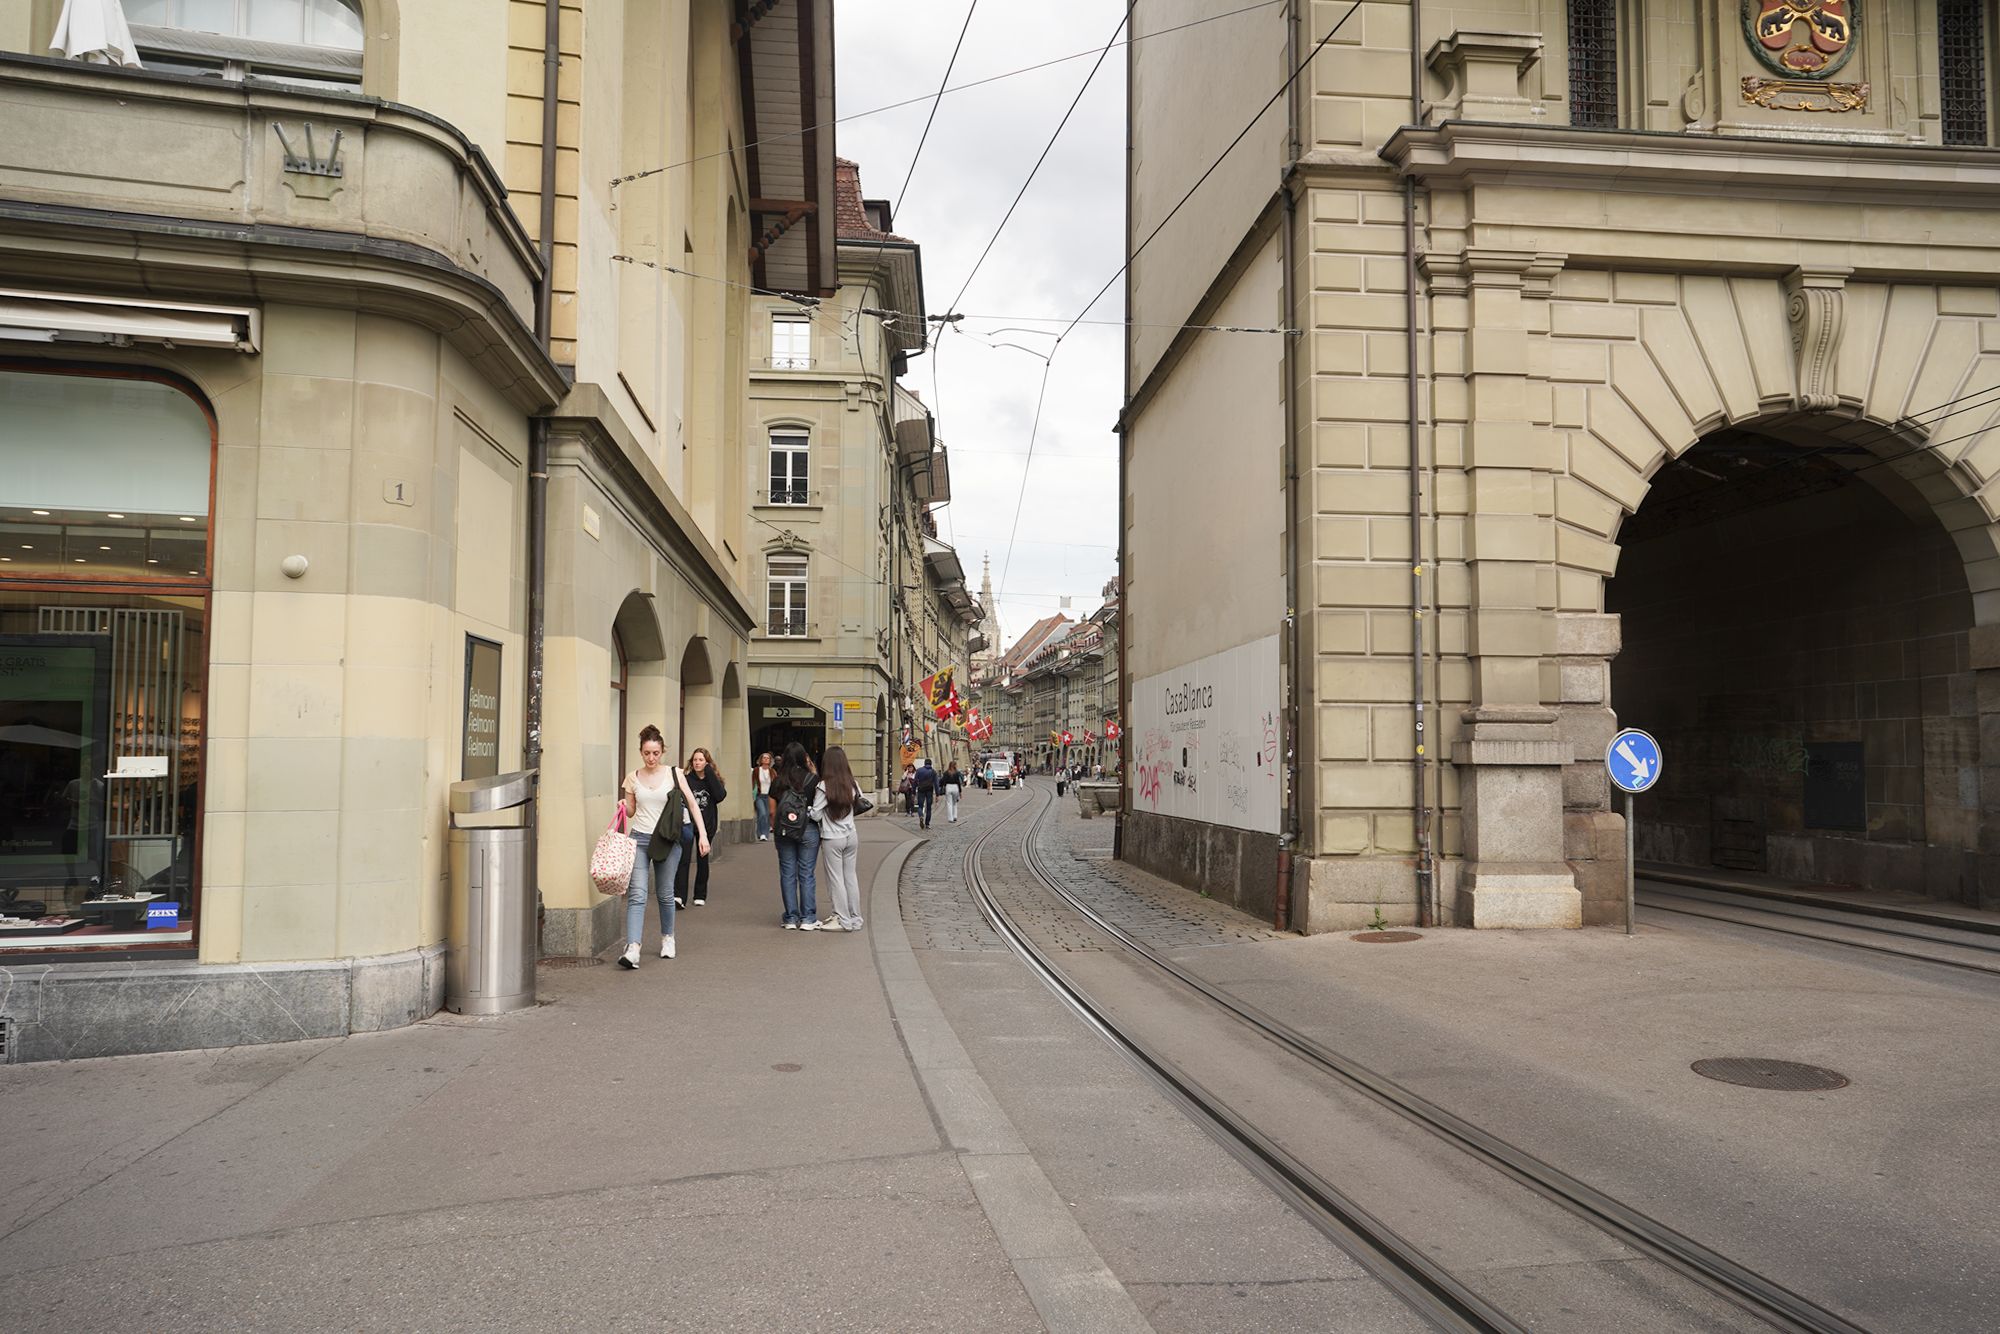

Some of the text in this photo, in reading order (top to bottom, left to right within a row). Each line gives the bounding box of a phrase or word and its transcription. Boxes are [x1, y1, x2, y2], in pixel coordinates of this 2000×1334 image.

[395, 483, 403, 501] 1
[469, 687, 496, 710] fielmann
[1165, 683, 1213, 715] CasaBlanca
[468, 711, 495, 733] fielmann
[467, 736, 494, 757] fielmann
[148, 909, 178, 917] ZEISS
